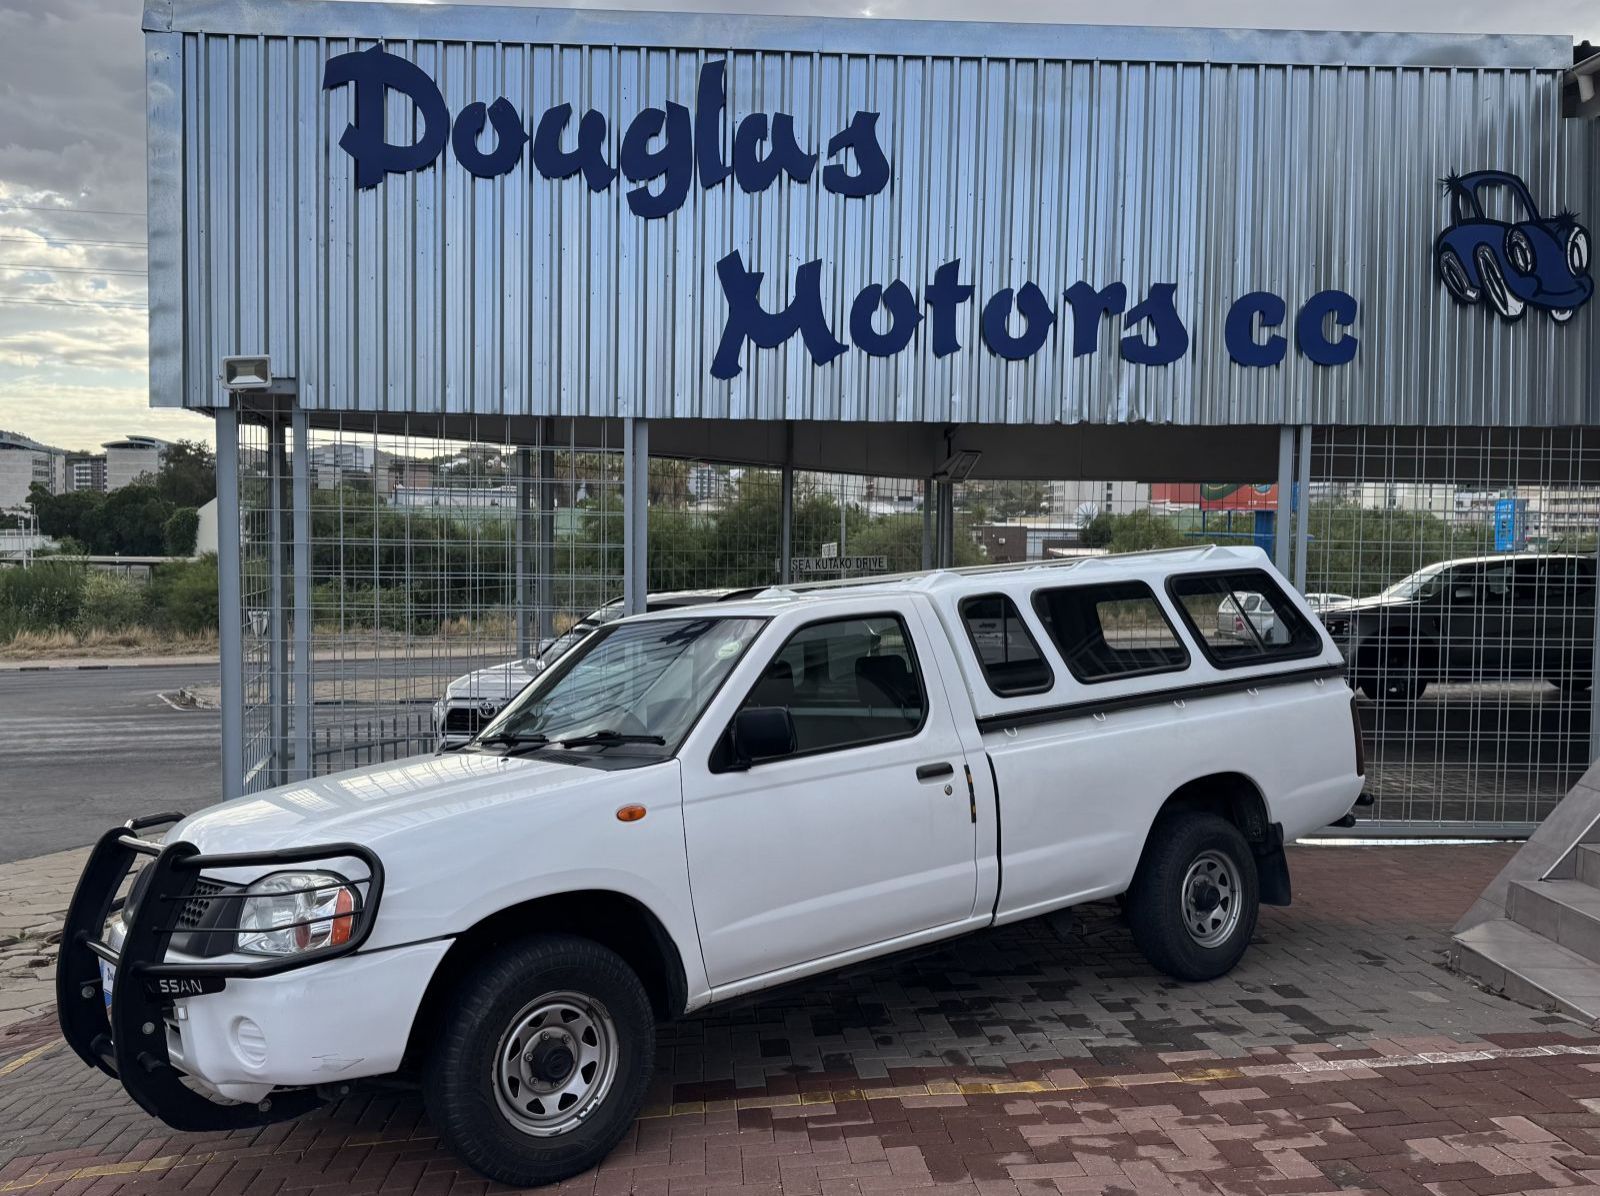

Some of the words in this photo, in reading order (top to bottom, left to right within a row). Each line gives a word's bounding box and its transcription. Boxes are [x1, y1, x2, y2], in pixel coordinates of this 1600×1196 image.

[322, 42, 890, 220] Douglas
[710, 249, 1190, 381] Motors
[1225, 290, 1358, 368] cc
[815, 557, 852, 570] KUTAKO
[856, 556, 884, 569] DRIVE
